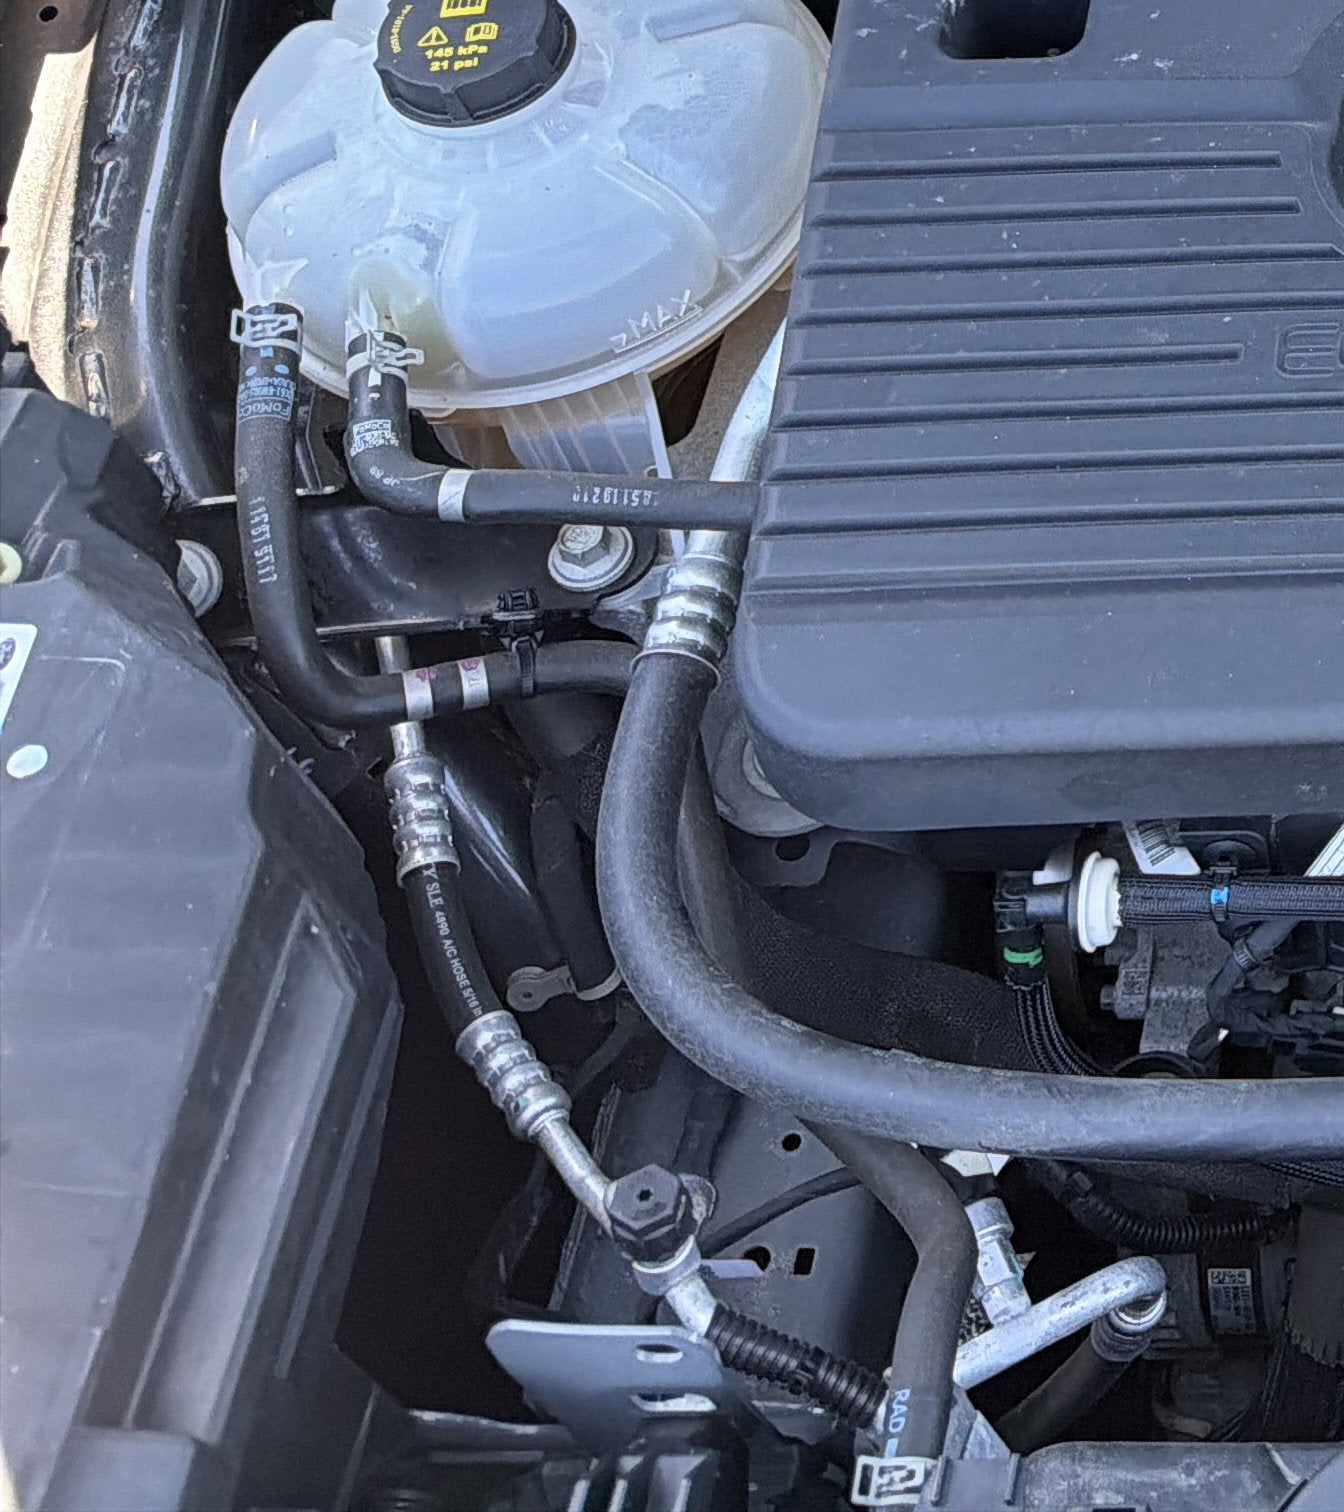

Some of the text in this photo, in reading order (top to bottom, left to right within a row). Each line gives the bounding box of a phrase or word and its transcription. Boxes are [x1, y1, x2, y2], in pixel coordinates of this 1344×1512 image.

[424, 44, 488, 60] 145 kPa
[429, 57, 479, 72] 21 psi
[426, 882, 444, 909] SLE
[435, 910, 450, 936] 4890
[442, 939, 457, 958] A/C
[450, 958, 471, 988] HOSE
[889, 1389, 910, 1433] RAD
